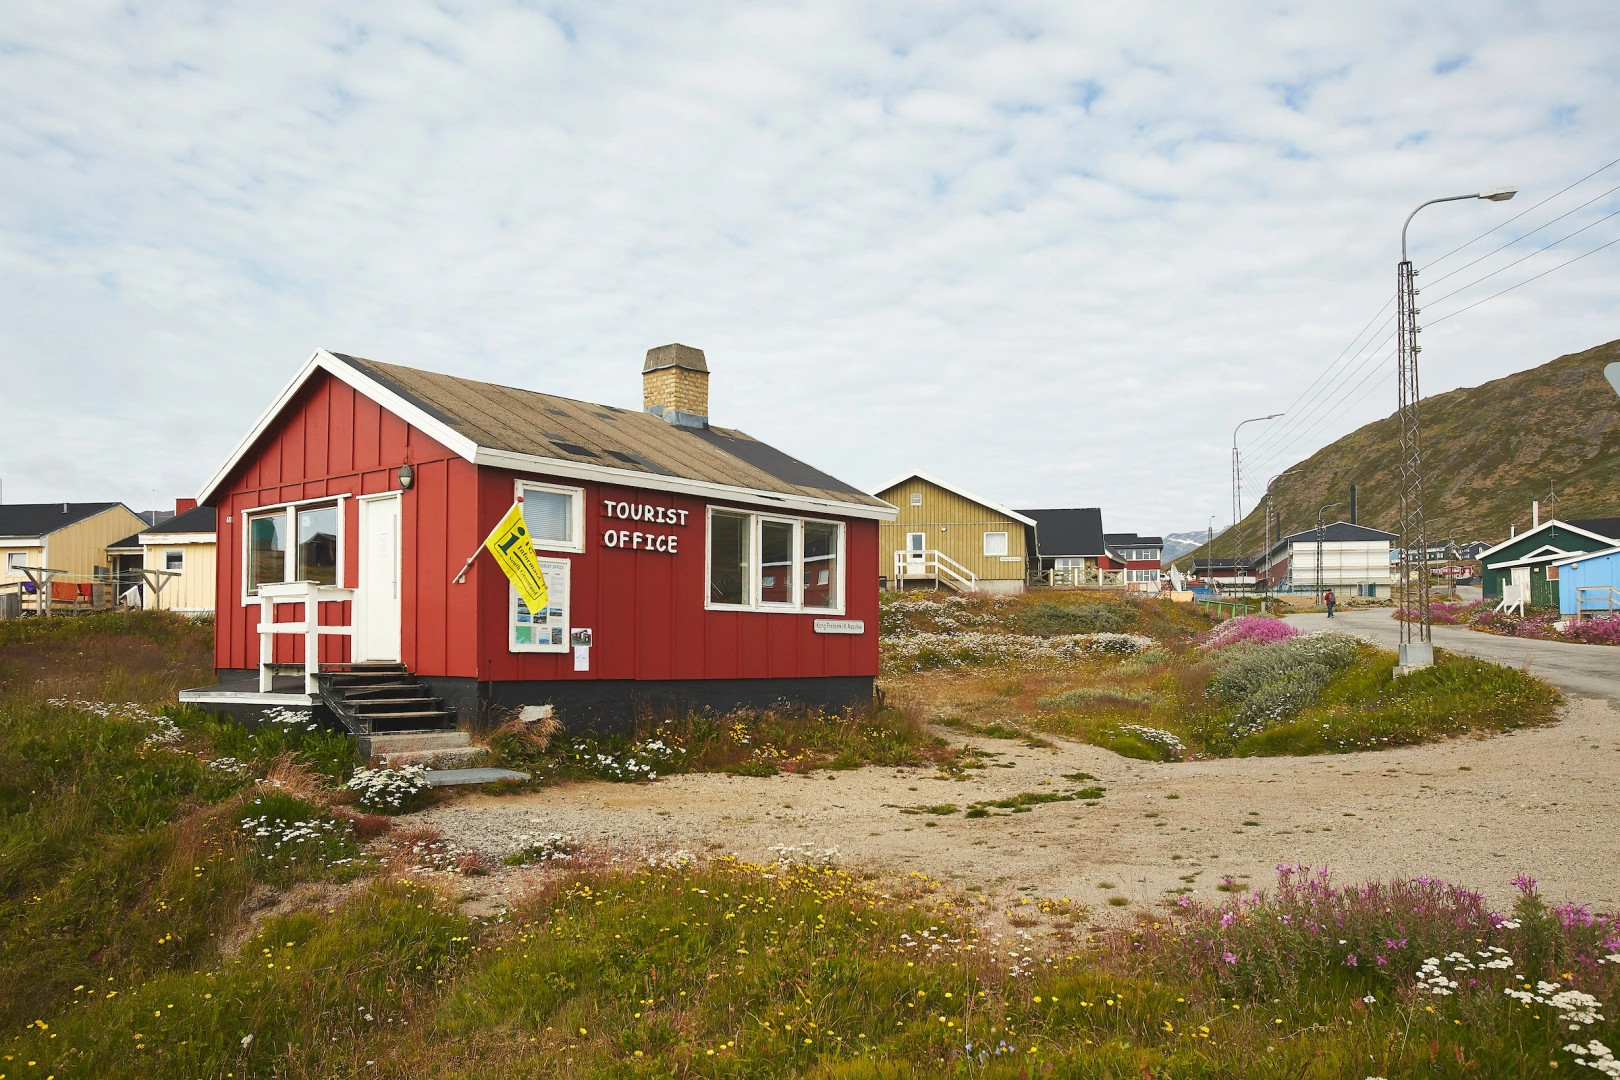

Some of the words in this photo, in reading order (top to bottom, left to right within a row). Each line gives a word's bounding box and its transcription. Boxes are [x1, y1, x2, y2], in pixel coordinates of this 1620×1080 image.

[603, 499, 689, 526] TOURIST
[604, 529, 678, 554] OFFICE
[508, 555, 521, 571] South
[520, 569, 538, 595] Greenland
